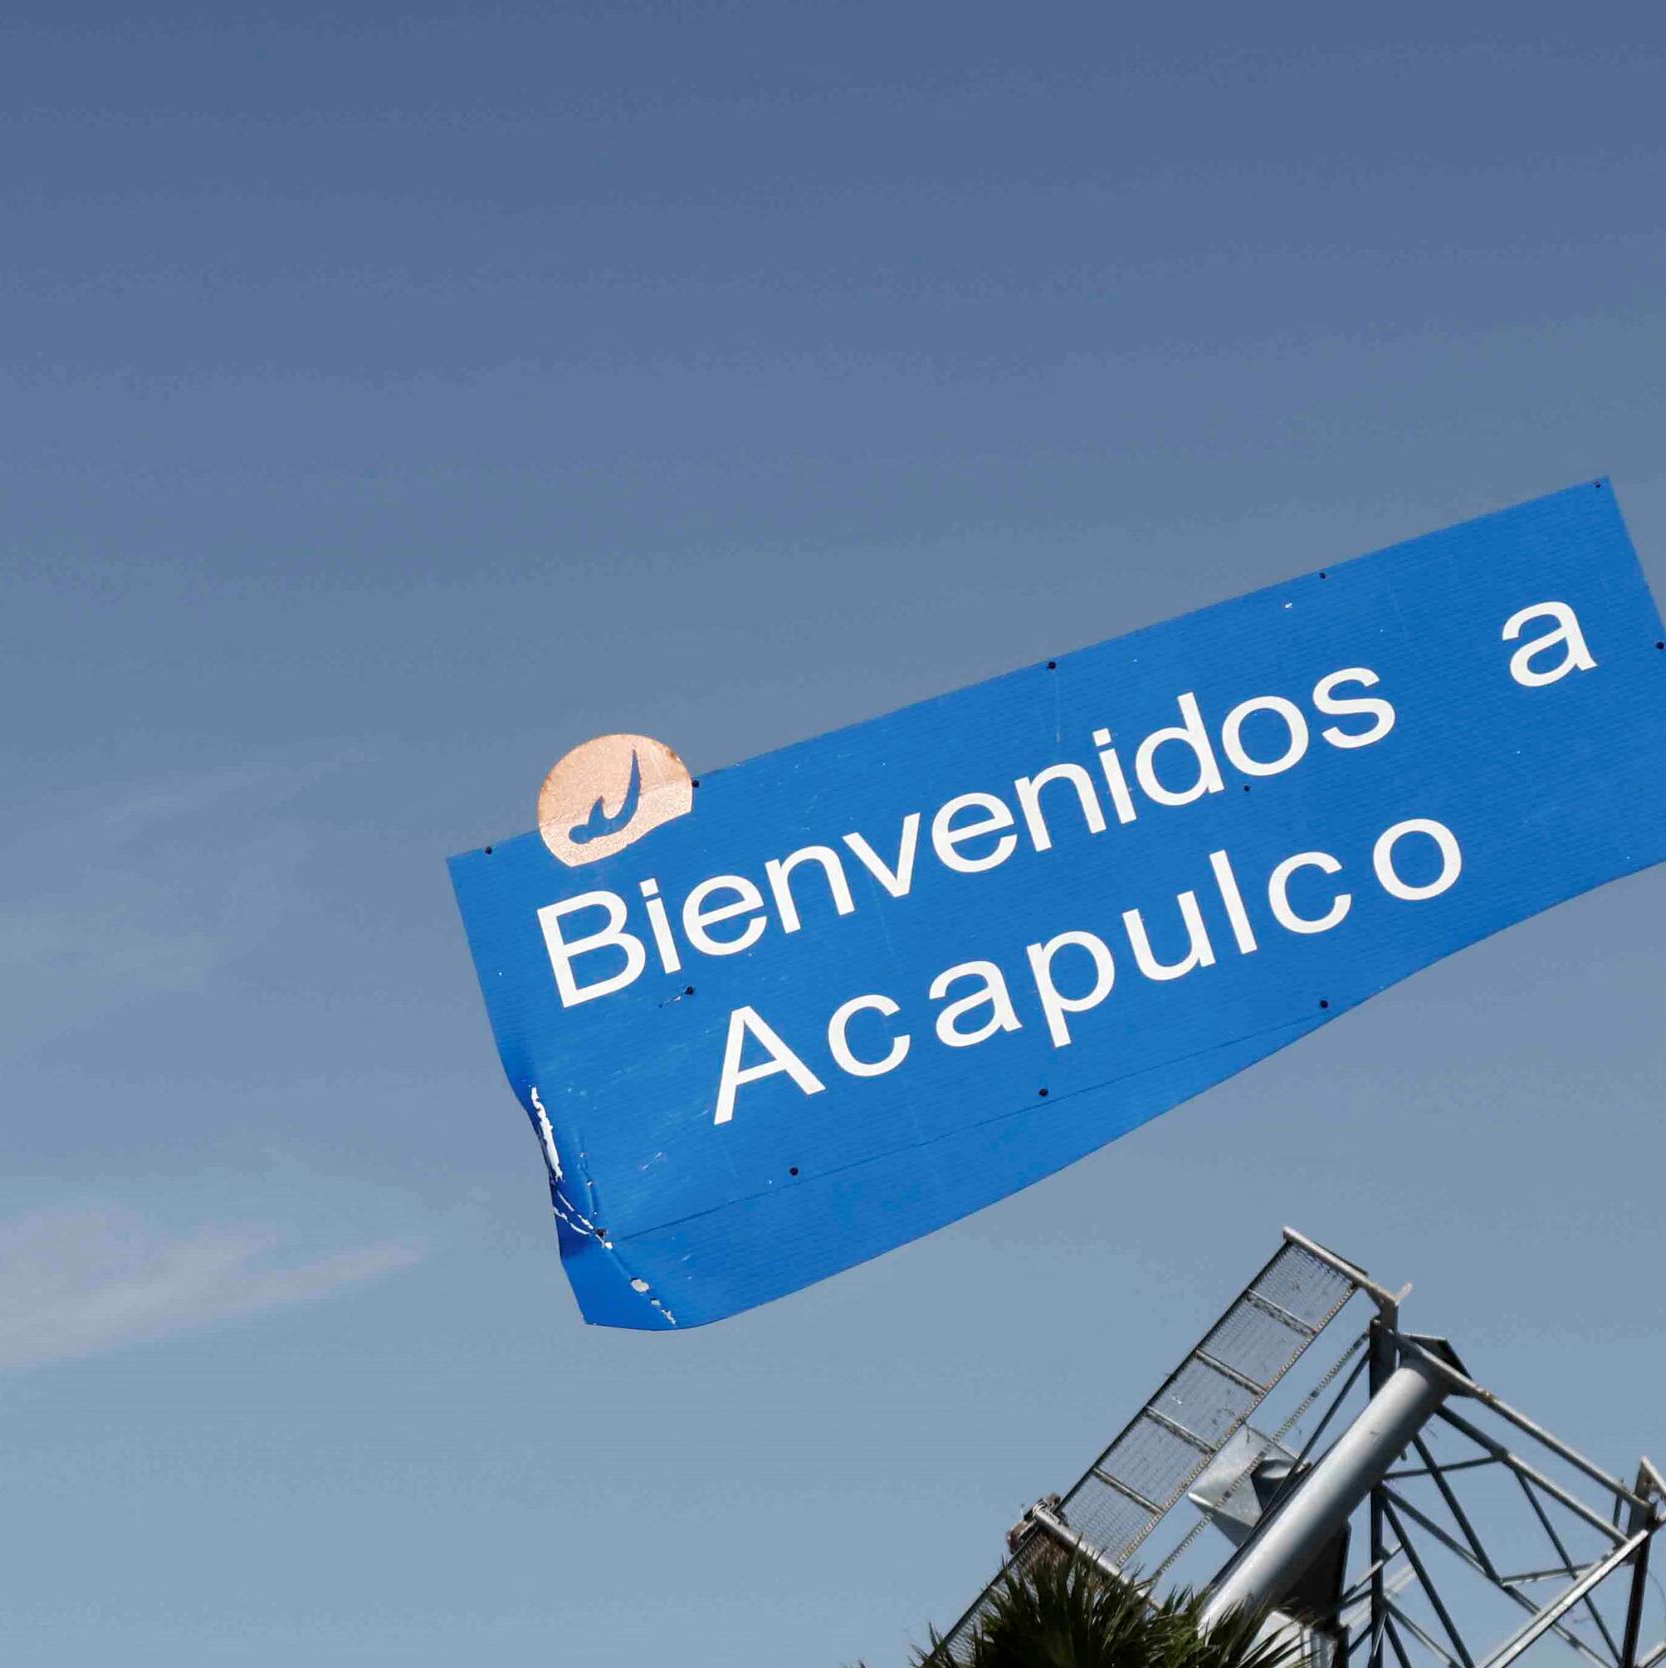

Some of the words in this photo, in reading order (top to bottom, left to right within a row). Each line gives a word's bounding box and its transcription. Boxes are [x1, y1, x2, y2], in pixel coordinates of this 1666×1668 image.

[537, 667, 1396, 1008] Bienvenidos
[1502, 601, 1597, 687] a
[714, 818, 1462, 1125] Acapulco
